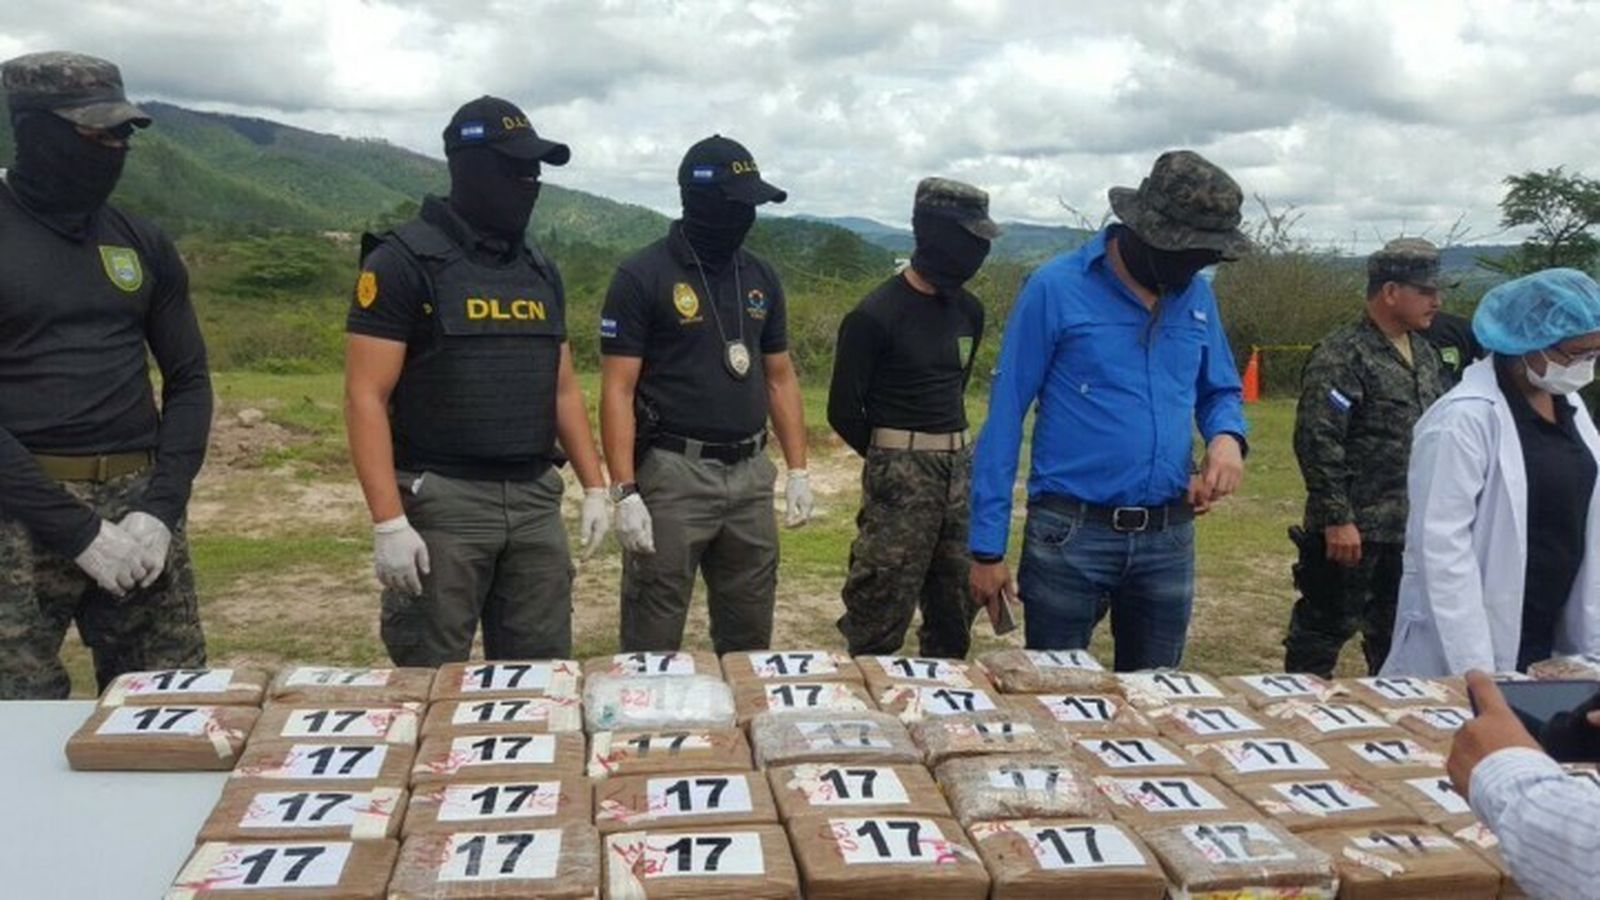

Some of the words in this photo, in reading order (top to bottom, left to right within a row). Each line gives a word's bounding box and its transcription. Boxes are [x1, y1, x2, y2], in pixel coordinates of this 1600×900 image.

[467, 298, 546, 320] DLCN
[766, 654, 813, 674] 17
[893, 659, 941, 679] 17
[153, 671, 210, 690] 17
[473, 665, 533, 688] 17
[1154, 673, 1200, 694] 17
[1262, 676, 1308, 692] 17
[1376, 679, 1424, 697] 17
[772, 685, 822, 706] 17
[933, 690, 975, 711] 17
[133, 709, 197, 730] 17
[472, 701, 531, 720] 17
[1064, 697, 1109, 720] 17
[1187, 709, 1239, 730] 17
[1422, 708, 1465, 724] 17
[302, 710, 367, 732] 17
[472, 737, 533, 760] 17
[629, 731, 691, 757] 17
[1101, 740, 1155, 763] 17
[1242, 741, 1299, 763] 17
[1365, 741, 1409, 763] 17
[307, 746, 375, 775] 17
[665, 779, 729, 811] 17
[820, 769, 878, 799] 17
[1140, 781, 1200, 807] 17
[1290, 783, 1349, 807] 17
[278, 793, 353, 821] 17
[472, 785, 539, 814] 17
[857, 820, 922, 857] 17
[1037, 827, 1103, 864] 17
[240, 846, 326, 885] 17
[456, 834, 534, 876] 17
[666, 837, 733, 871] 17
